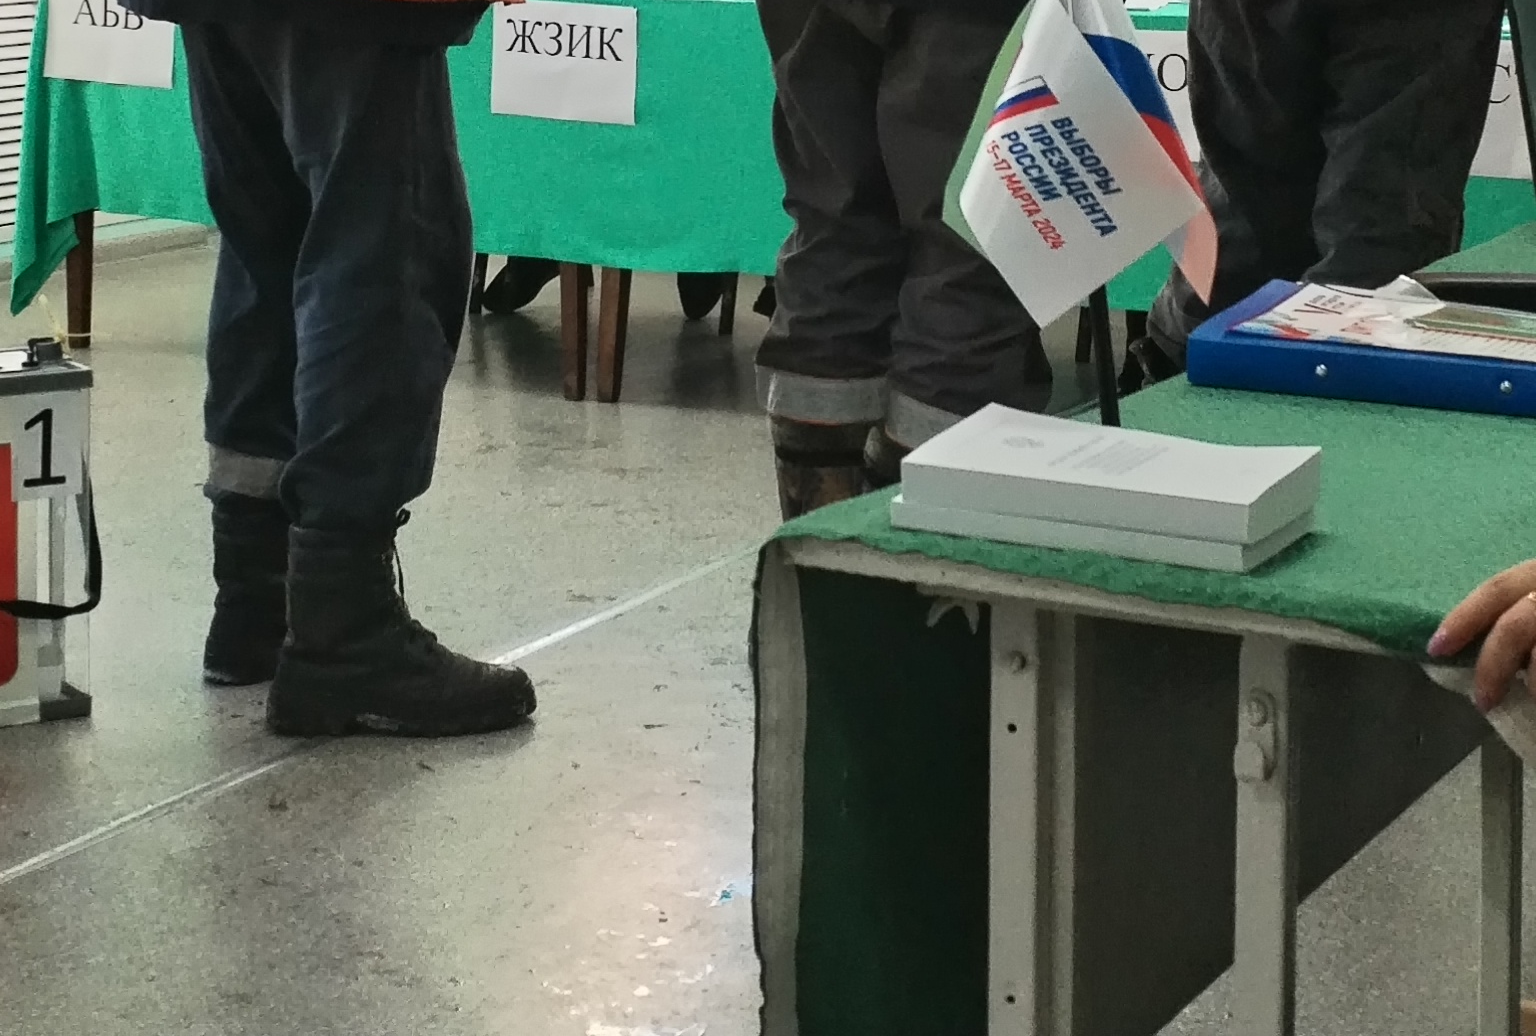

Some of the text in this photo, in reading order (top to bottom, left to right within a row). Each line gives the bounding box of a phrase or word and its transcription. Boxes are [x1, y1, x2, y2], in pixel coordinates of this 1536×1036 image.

[505, 18, 624, 62] ЖЗИК
[1001, 130, 1063, 201] РОССИИ
[1024, 123, 1118, 237] ПРЕЗИДЕНТА
[1050, 116, 1123, 196] ВЫБОРЫ
[1000, 172, 1042, 218] МАРТА
[1032, 217, 1066, 250] 2024
[23, 407, 67, 489] 1
